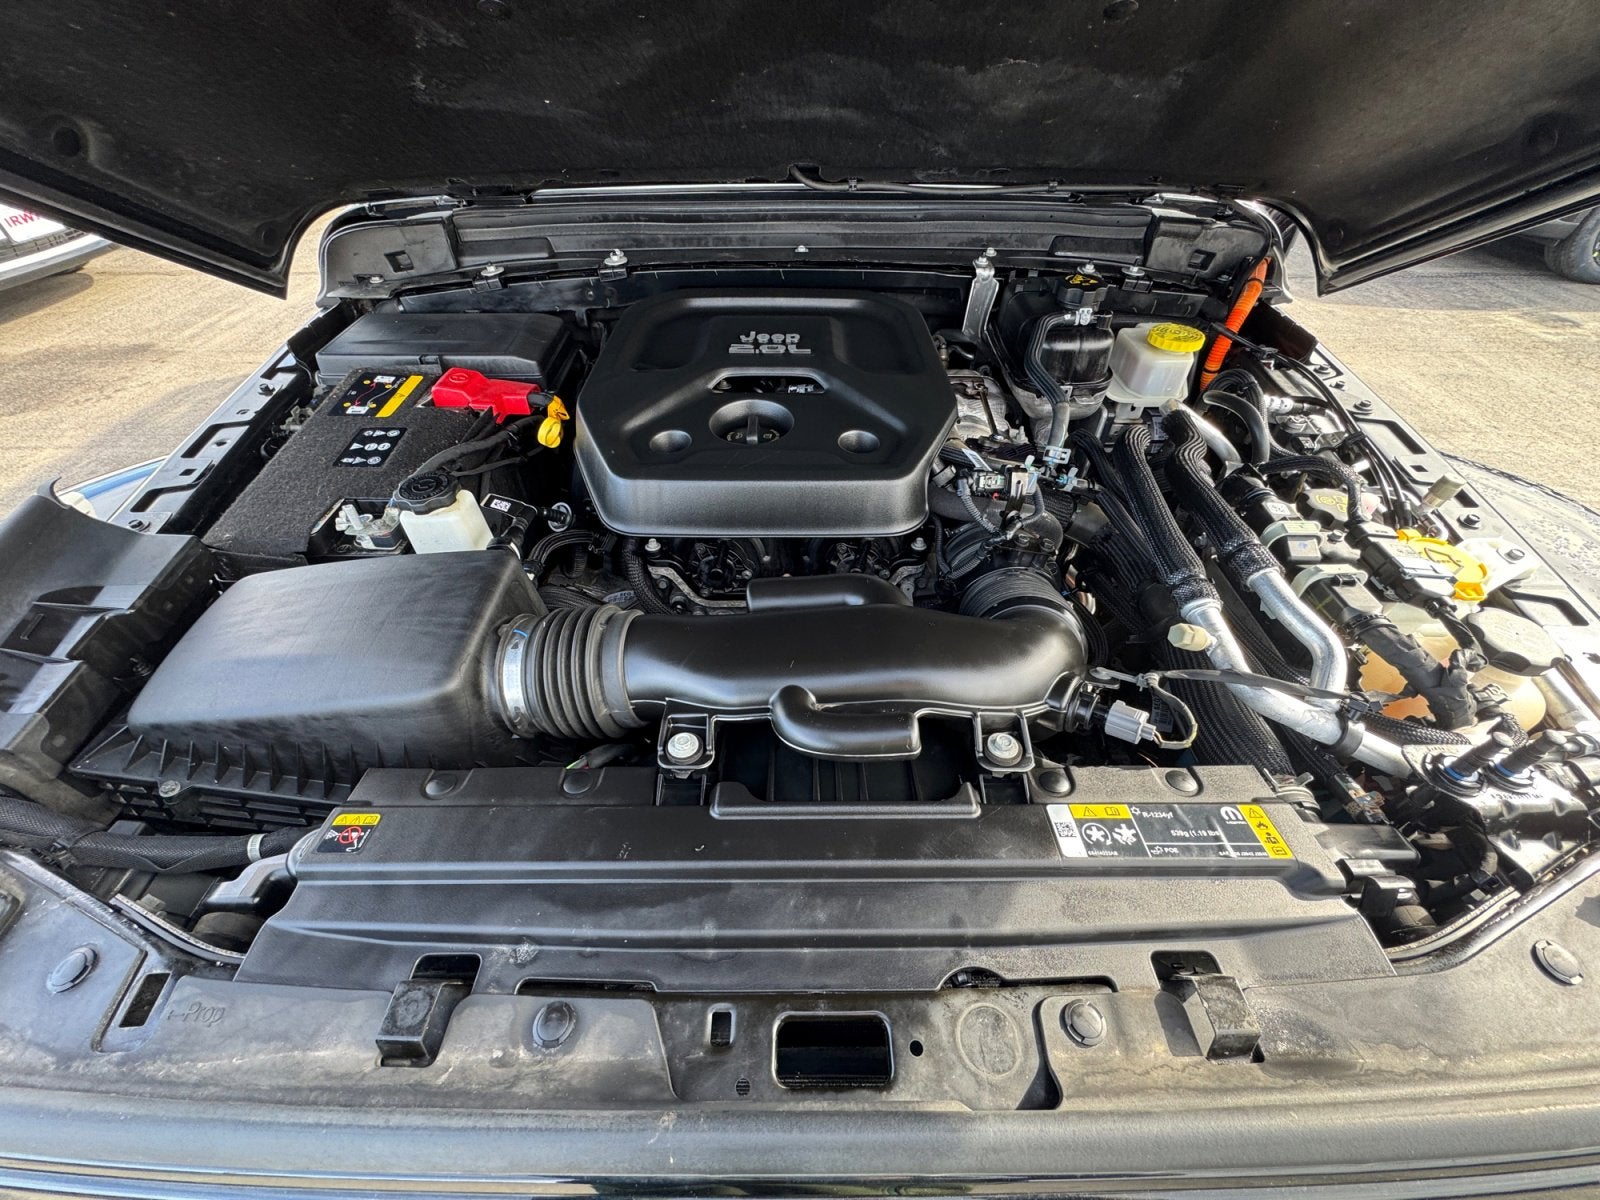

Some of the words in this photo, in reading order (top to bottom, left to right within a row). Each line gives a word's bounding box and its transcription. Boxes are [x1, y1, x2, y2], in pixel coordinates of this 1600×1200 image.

[4, 210, 37, 228] IRW
[739, 331, 801, 344] Jeep
[728, 343, 812, 354] 2.0L
[183, 1001, 226, 1028] Prop
